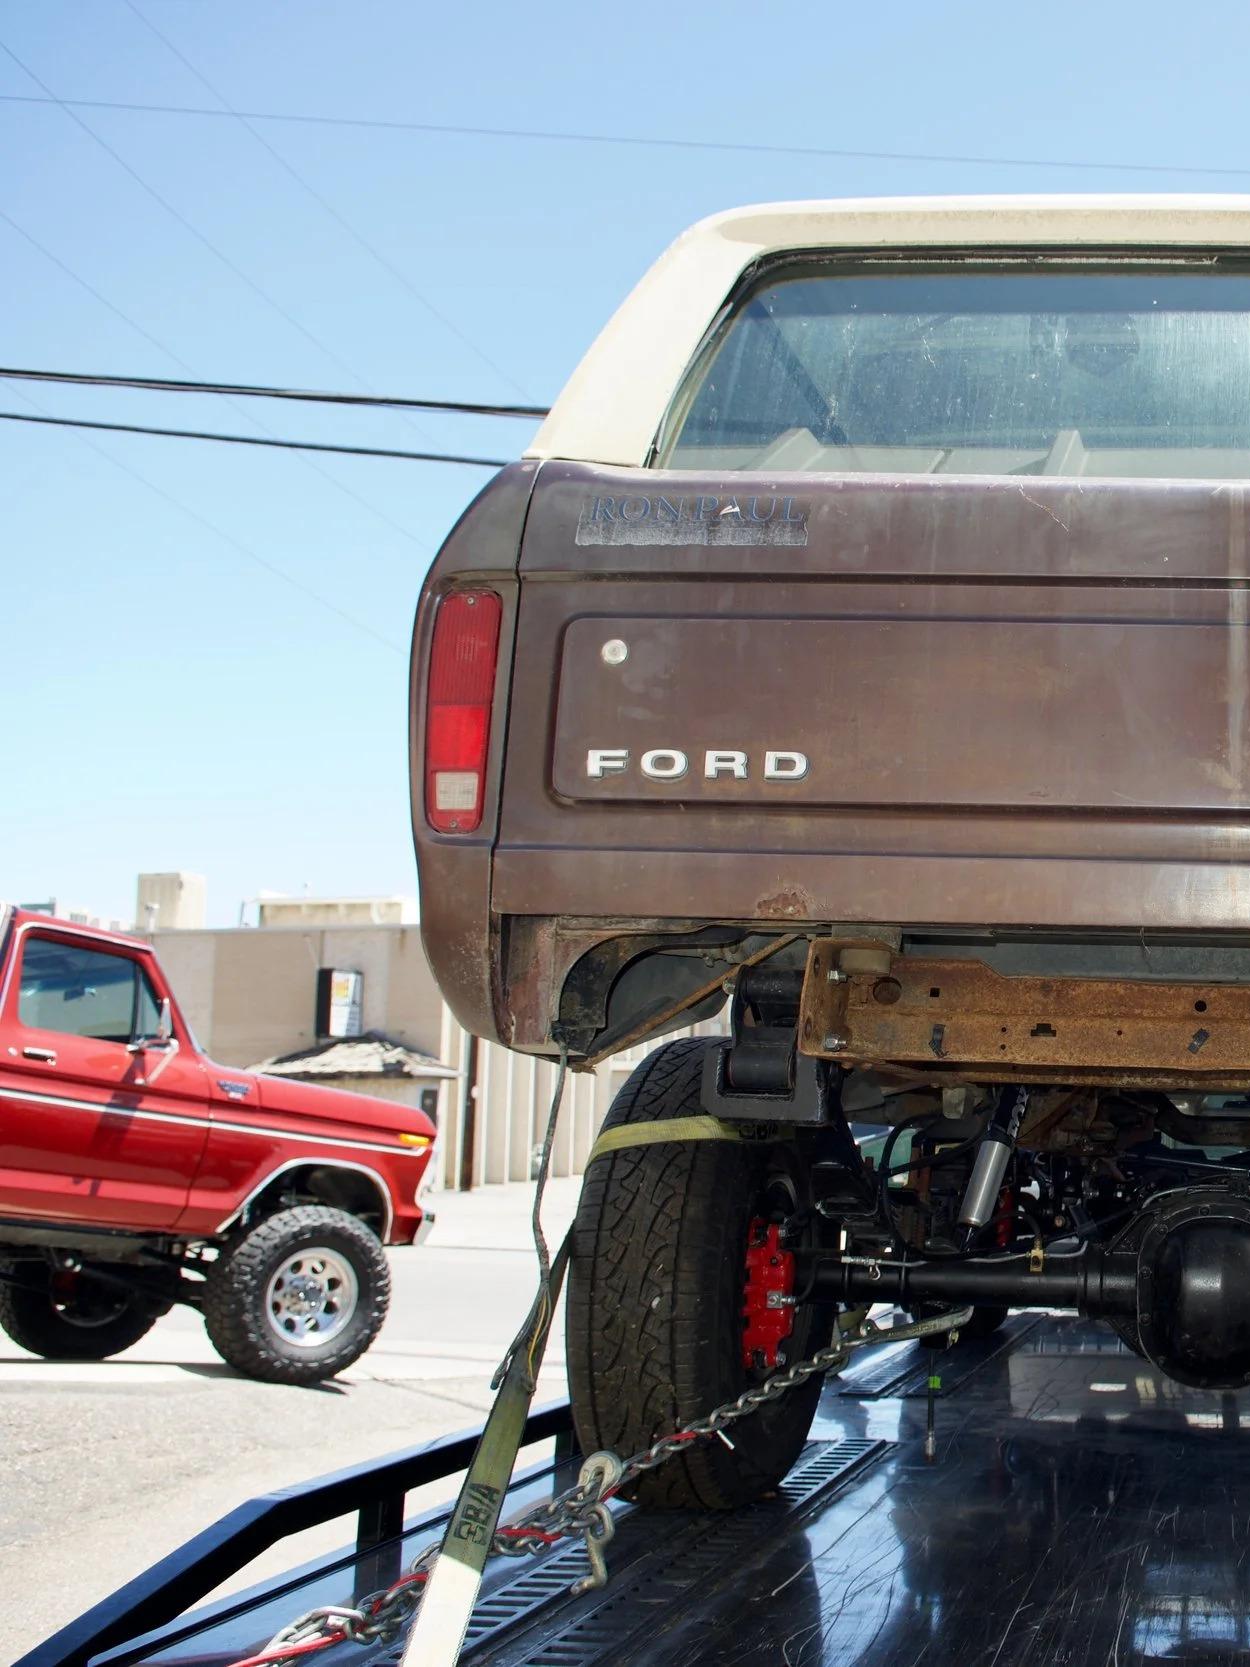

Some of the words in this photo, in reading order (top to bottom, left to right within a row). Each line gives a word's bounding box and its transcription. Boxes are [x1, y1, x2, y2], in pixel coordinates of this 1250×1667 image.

[591, 496, 685, 522] RON
[694, 496, 803, 522] PAUL
[587, 749, 810, 780] FORD
